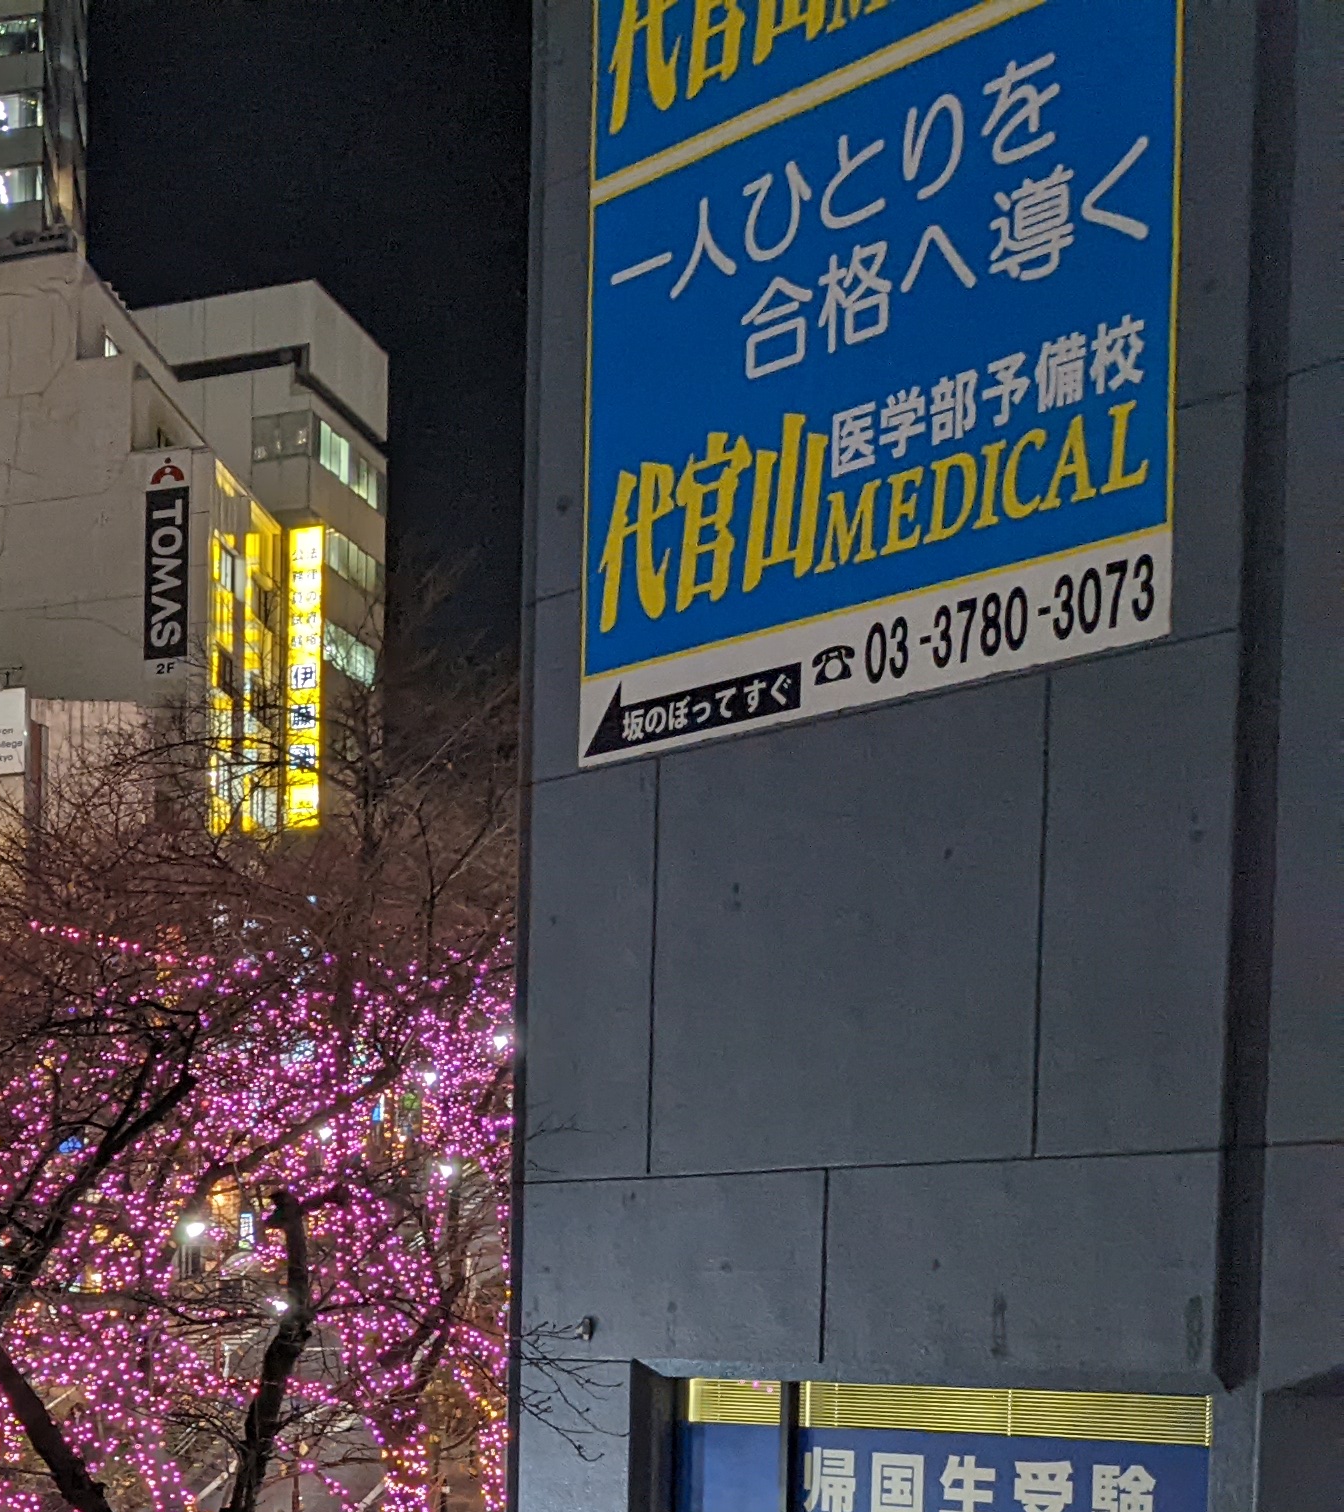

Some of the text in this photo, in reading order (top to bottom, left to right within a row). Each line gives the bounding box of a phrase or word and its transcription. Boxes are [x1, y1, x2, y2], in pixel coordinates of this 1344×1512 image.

[610, 52, 1060, 300] 一人ひとりを
[740, 136, 1150, 381] 合格へ導く
[831, 315, 1146, 478] 医学部予備校
[150, 498, 183, 648] TOMAS
[598, 400, 1150, 633] 代官山 MEDICAL
[156, 661, 176, 676] 2F
[864, 552, 1157, 685] 03-3780-3073
[622, 675, 794, 746] 坂のぼってすぐ
